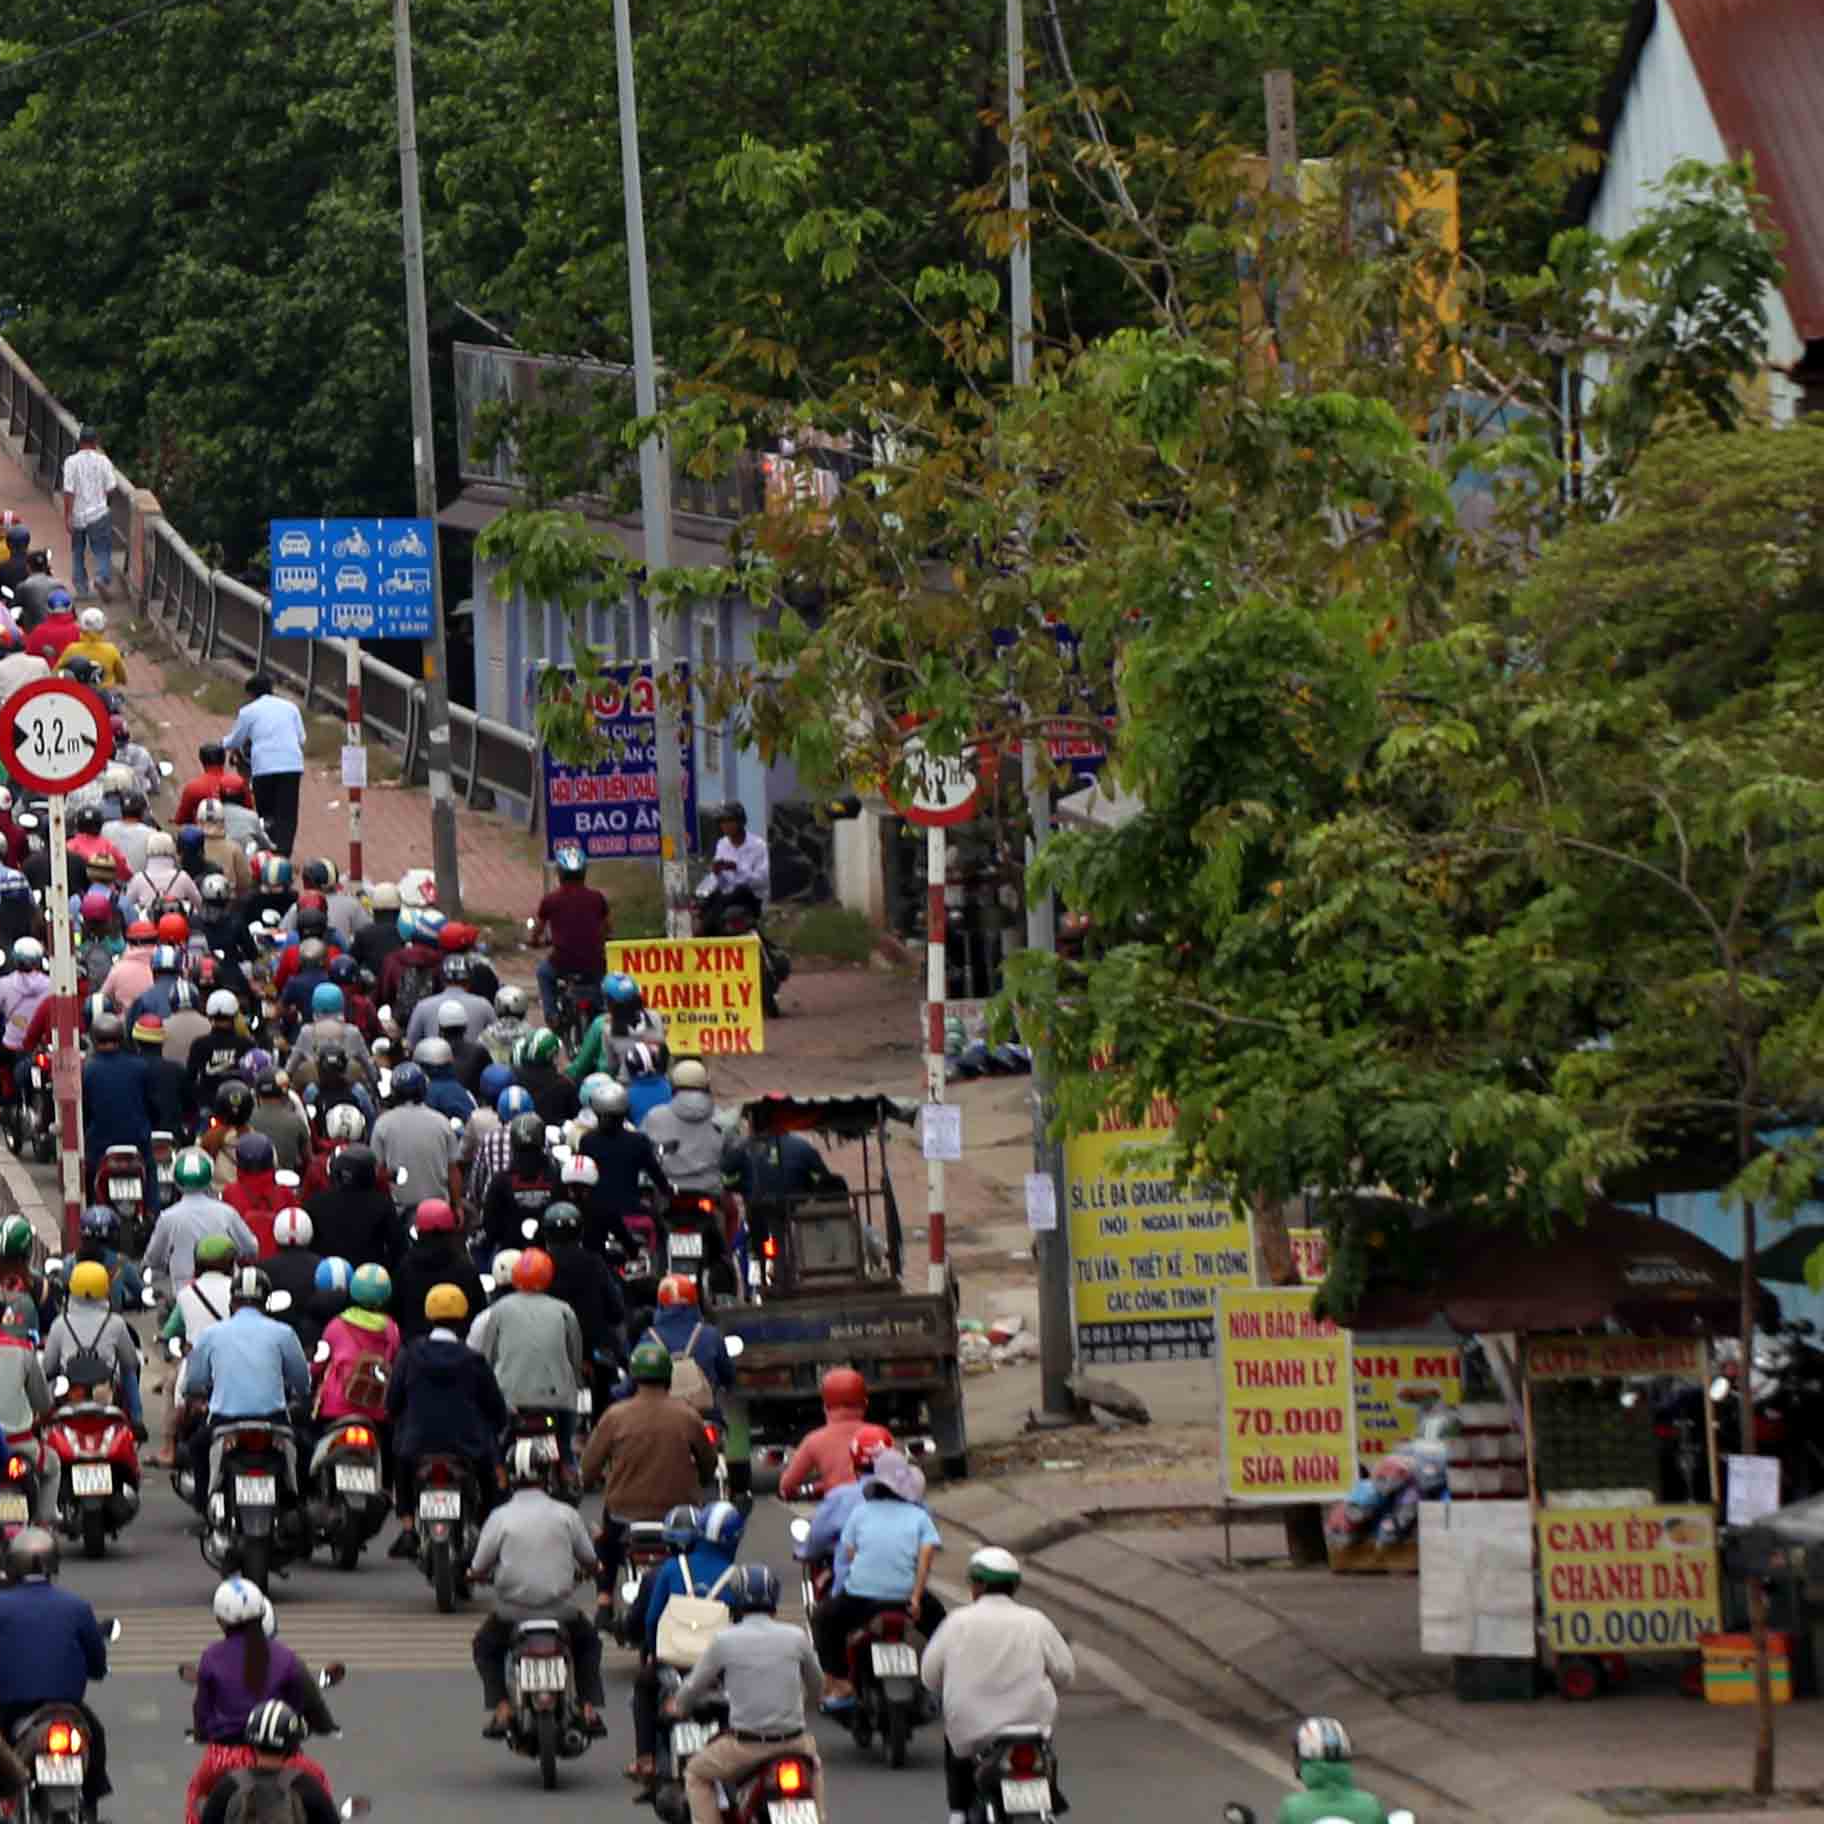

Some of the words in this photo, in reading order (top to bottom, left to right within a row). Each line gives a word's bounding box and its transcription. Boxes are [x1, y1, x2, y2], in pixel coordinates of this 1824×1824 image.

[576, 811, 627, 832] BAO
[1353, 1358, 1400, 1377] NH
[1232, 1407, 1343, 1437] 70.000
[1546, 1520, 1616, 1552] CAM
[1550, 1563, 1645, 1601] CHANH
